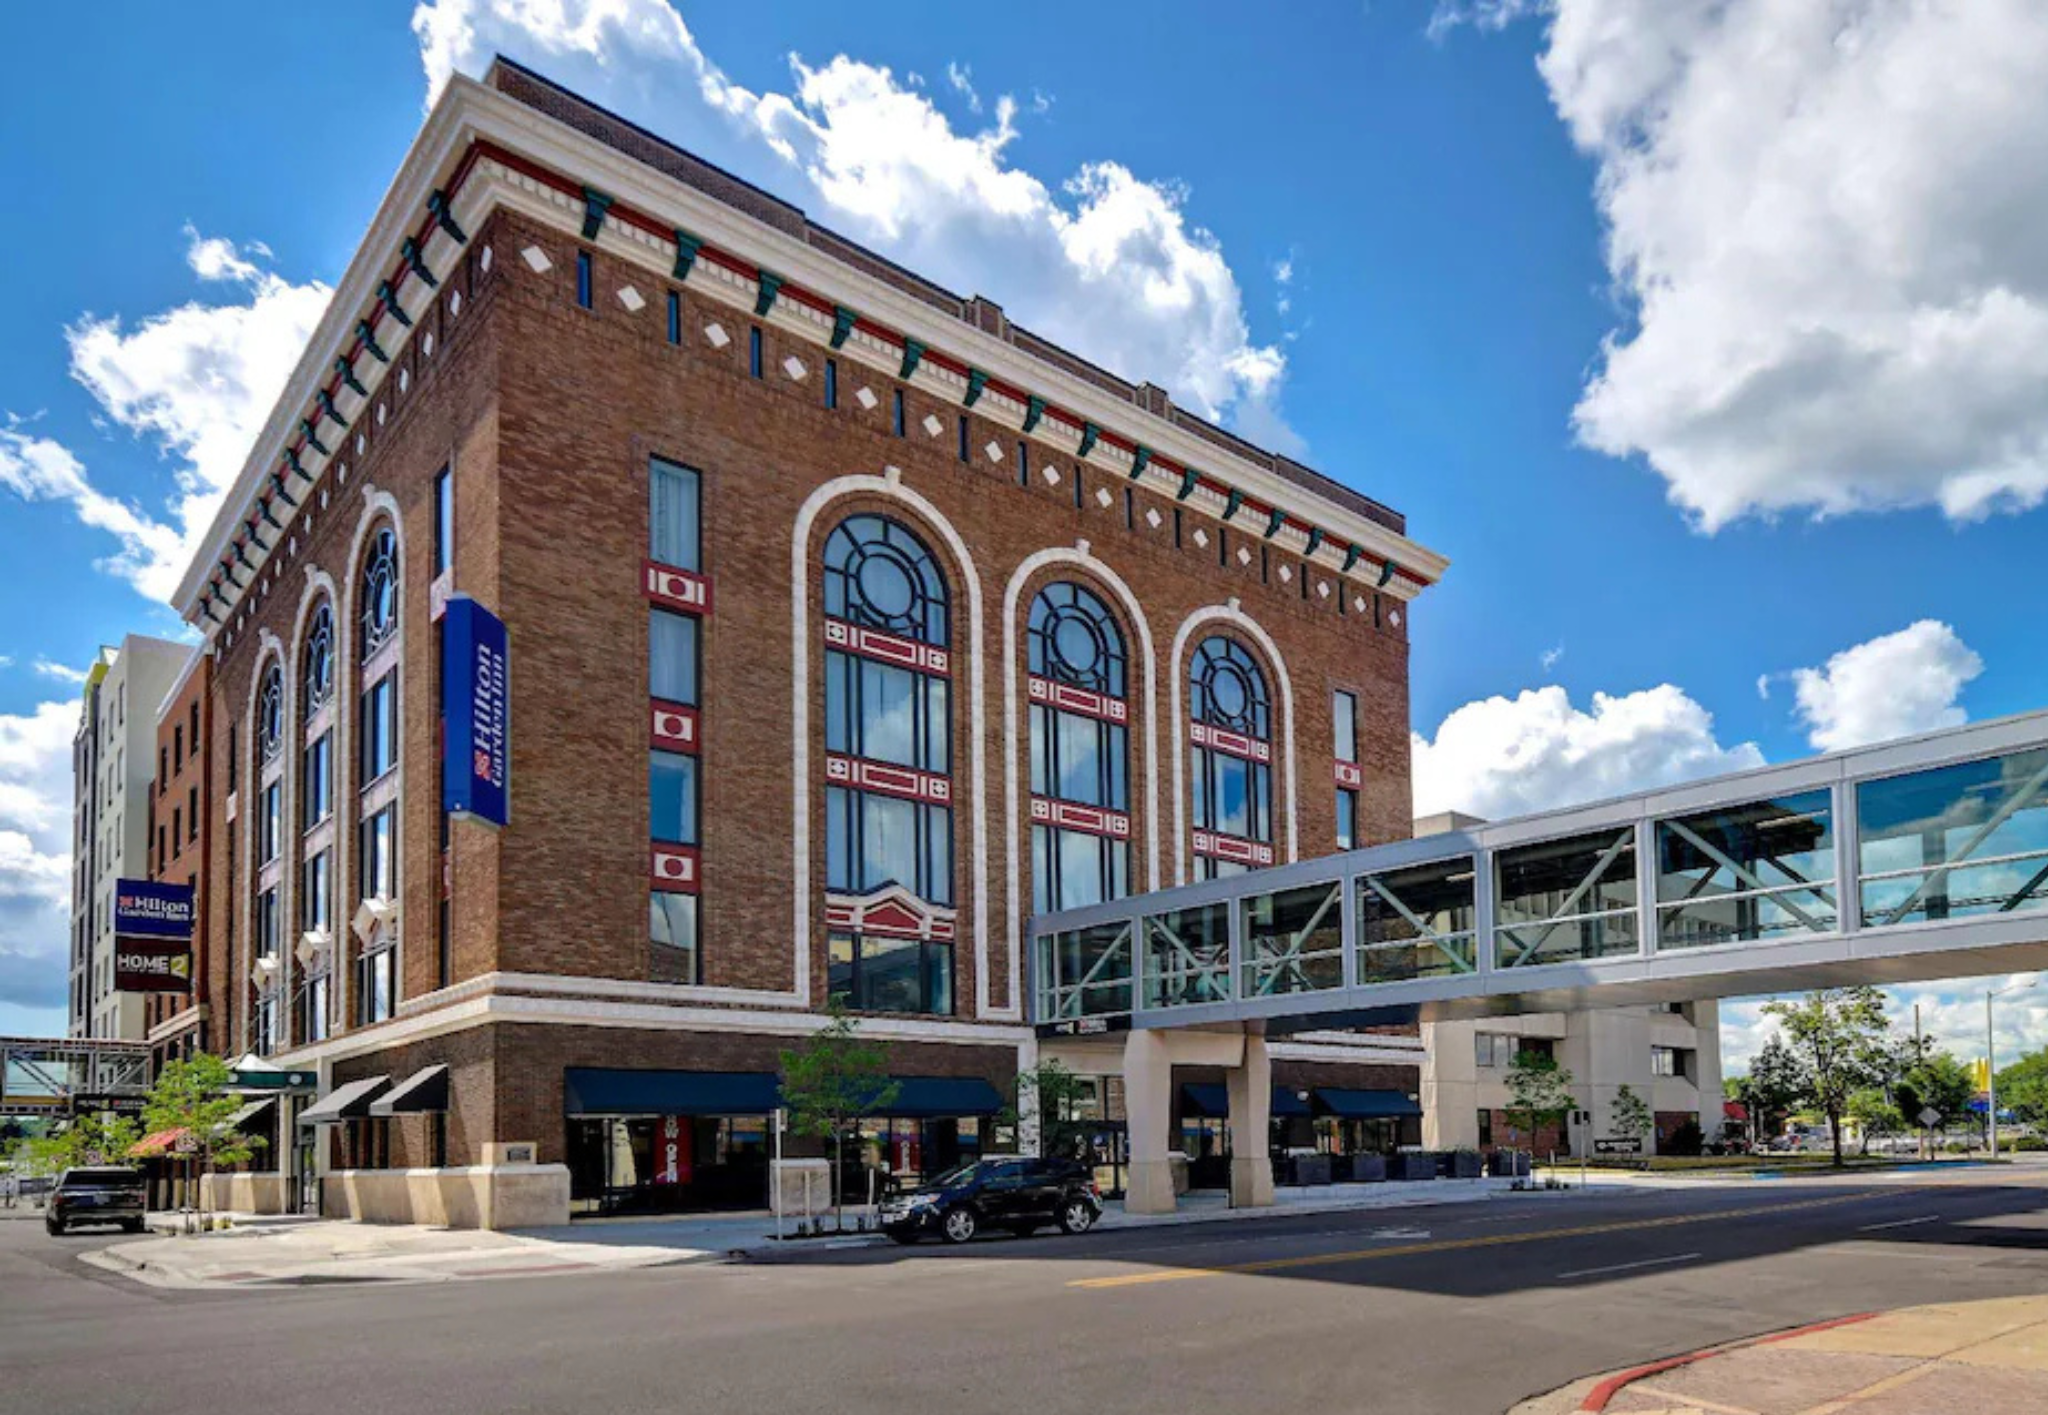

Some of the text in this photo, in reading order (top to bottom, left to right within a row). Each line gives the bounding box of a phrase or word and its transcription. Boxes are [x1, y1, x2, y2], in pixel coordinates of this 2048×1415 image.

[474, 643, 491, 752] Hilton
[491, 653, 504, 788] Garden Inn
[134, 896, 190, 913] Hilton
